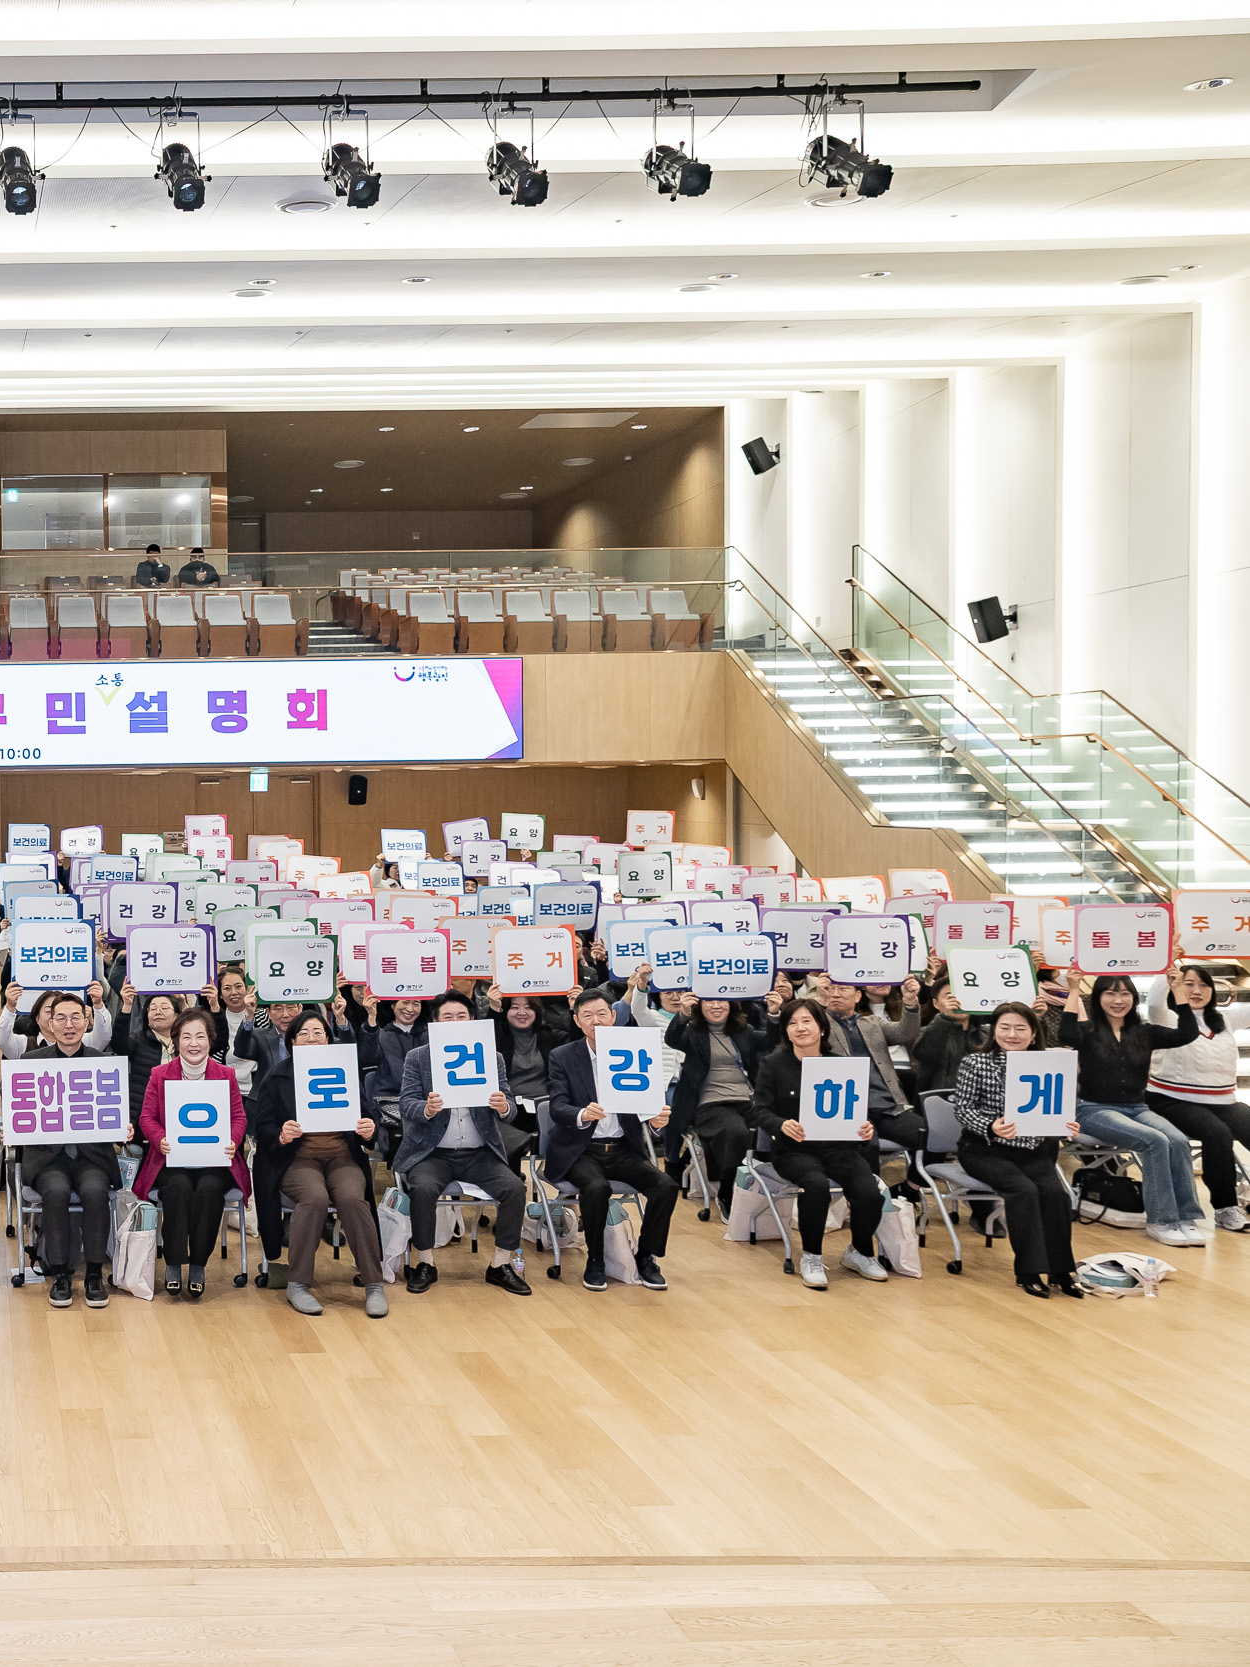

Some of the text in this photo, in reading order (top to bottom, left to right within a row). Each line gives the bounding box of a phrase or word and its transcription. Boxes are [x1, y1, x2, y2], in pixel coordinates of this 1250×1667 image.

[95, 672, 124, 687] 소통
[0, 748, 42, 760] 10:00
[13, 838, 47, 847] 보건의료
[95, 870, 134, 881] 보건의료
[422, 877, 460, 887] 보건의료
[539, 903, 593, 916] 보건의료
[223, 929, 236, 942] 요
[319, 922, 332, 935] 돌
[1056, 931, 1072, 945] 주
[20, 947, 88, 963] 보건의료
[353, 945, 366, 960] 돌
[452, 940, 467, 955] 주
[616, 943, 644, 957] 보건
[656, 951, 687, 967] 보건
[698, 959, 768, 975] 보건의료
[444, 1041, 487, 1087] 건
[608, 1048, 652, 1092] 강
[307, 1067, 350, 1109] 로
[1017, 1072, 1064, 1116] 게
[11, 1068, 122, 1134] 통합돌봄
[813, 1078, 860, 1121] 하
[177, 1103, 220, 1144] 으
